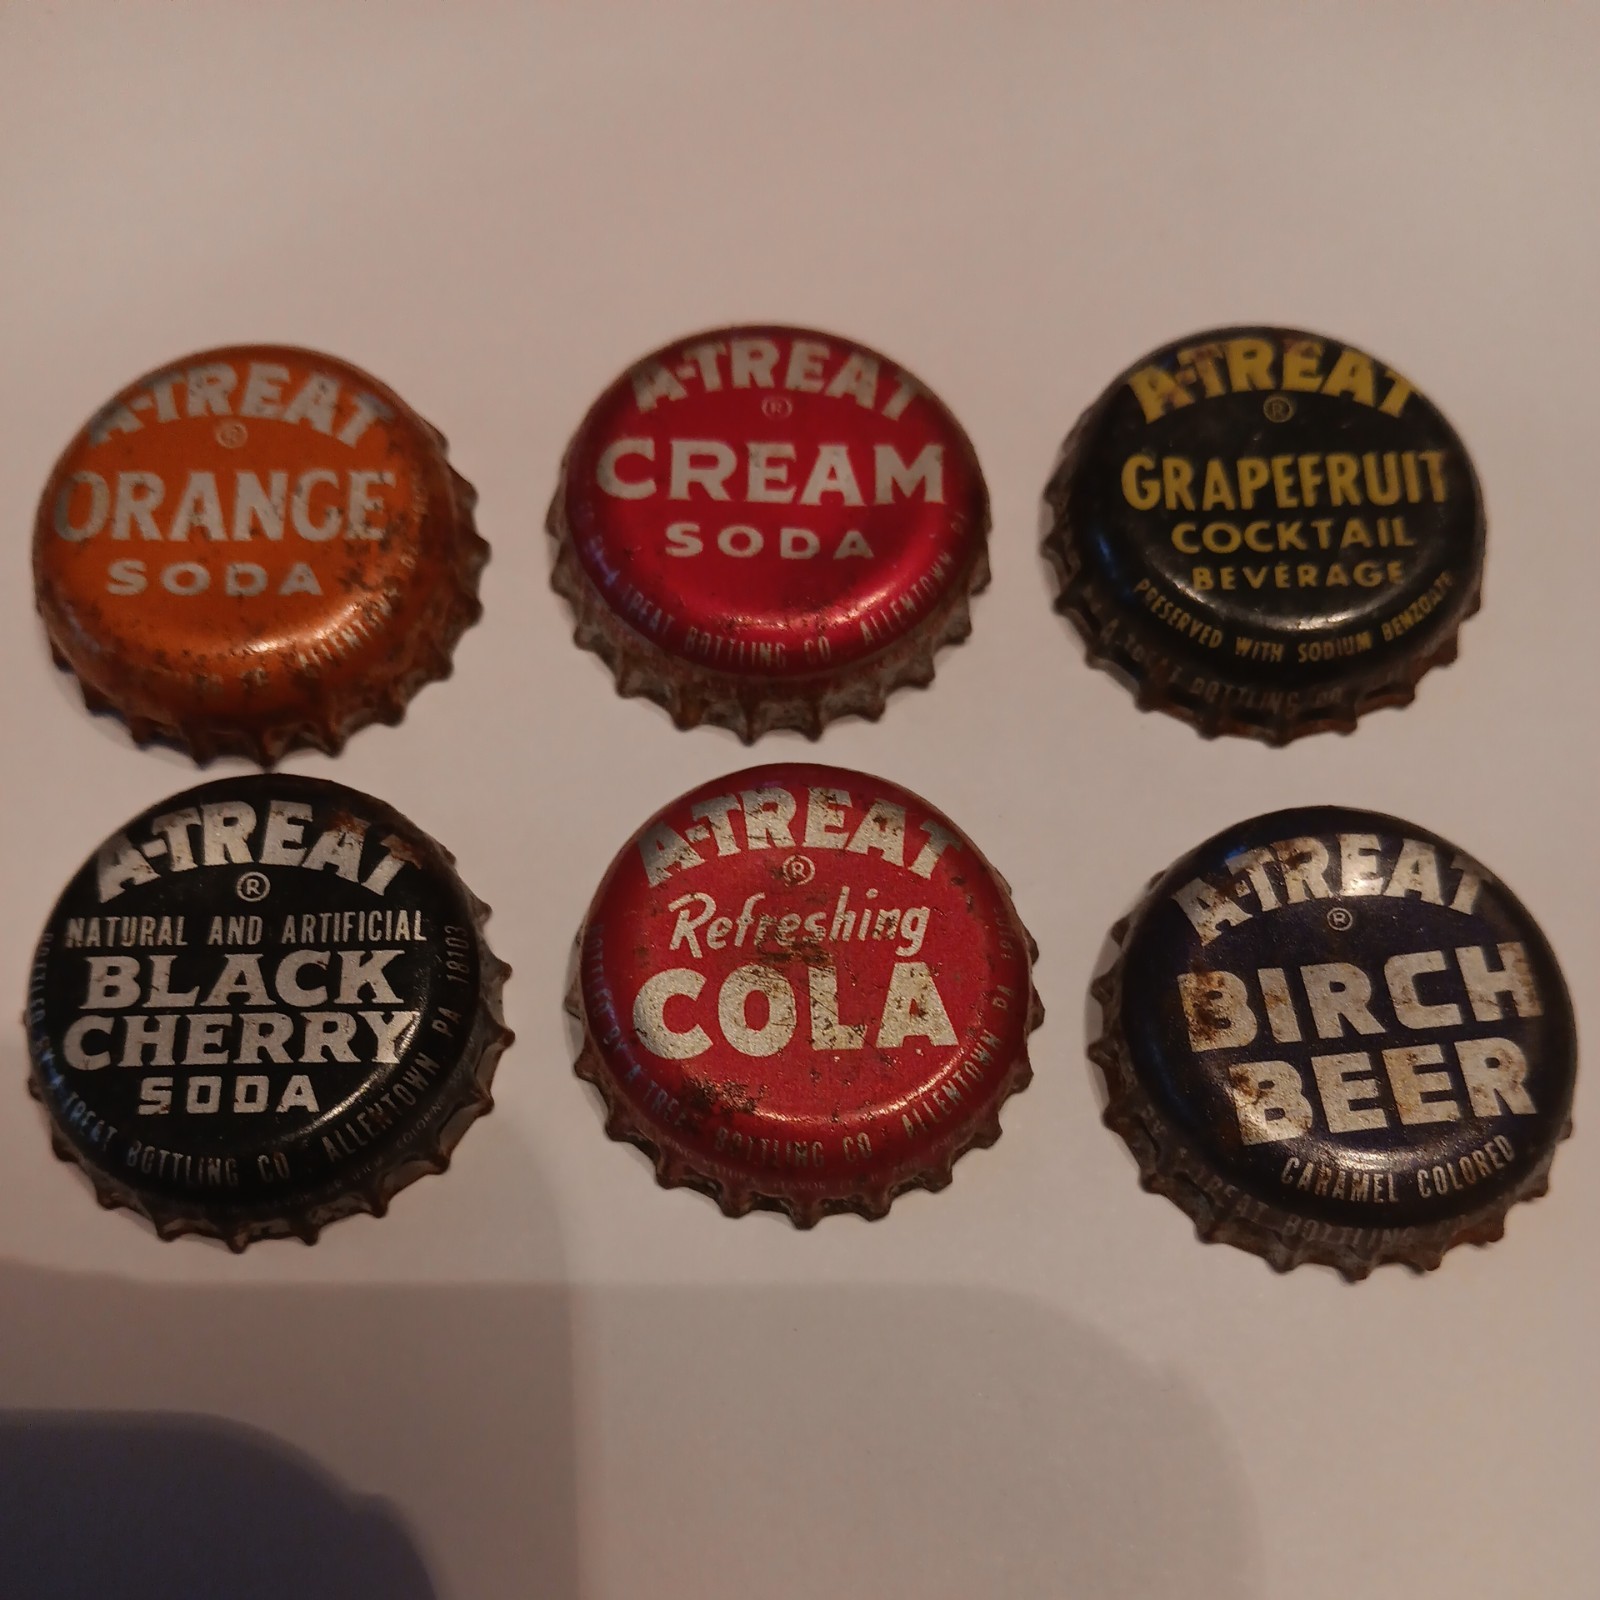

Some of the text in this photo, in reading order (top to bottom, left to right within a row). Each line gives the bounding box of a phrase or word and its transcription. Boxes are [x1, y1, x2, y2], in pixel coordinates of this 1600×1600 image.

[86, 362, 396, 447] A-TREAT
[630, 337, 925, 421] A-TREAT
[1127, 338, 1422, 424] A-TREAT
[54, 470, 396, 541] ORANGE
[596, 437, 946, 506] CREAM
[1121, 449, 1448, 511] GRAPEFRUIT
[664, 520, 875, 560] SODA
[1171, 517, 1416, 554] COCKTAIL
[105, 560, 323, 597] SODA
[1192, 559, 1405, 591] BEVERAGE
[1133, 570, 1454, 664] PRESERVED WITH SODIUM BENZOATE
[98, 800, 420, 903] A-TREAT
[637, 786, 960, 888] A-TREAT
[667, 886, 931, 958] Refreshing
[1173, 833, 1492, 947] A-TREAT
[64, 908, 428, 948] NATURAL AND ARTIFICIAL
[443, 924, 471, 985] 18103
[78, 949, 405, 1011] BLACK
[633, 961, 960, 1060] COLA
[1176, 941, 1543, 1052] BIRCH
[62, 1009, 421, 1071] CHERRY
[431, 1005, 463, 1037] PA
[137, 1074, 320, 1116] SODA
[320, 1050, 442, 1163] ALLENTOWN
[842, 1131, 873, 1162] CO
[901, 1028, 1001, 1140] ALLENTOWN
[1229, 1036, 1538, 1146] BEER
[126, 1139, 240, 1188] BOTTLING
[257, 1151, 291, 1184] CO
[1281, 1134, 1517, 1204] CARAMEL COLORED
